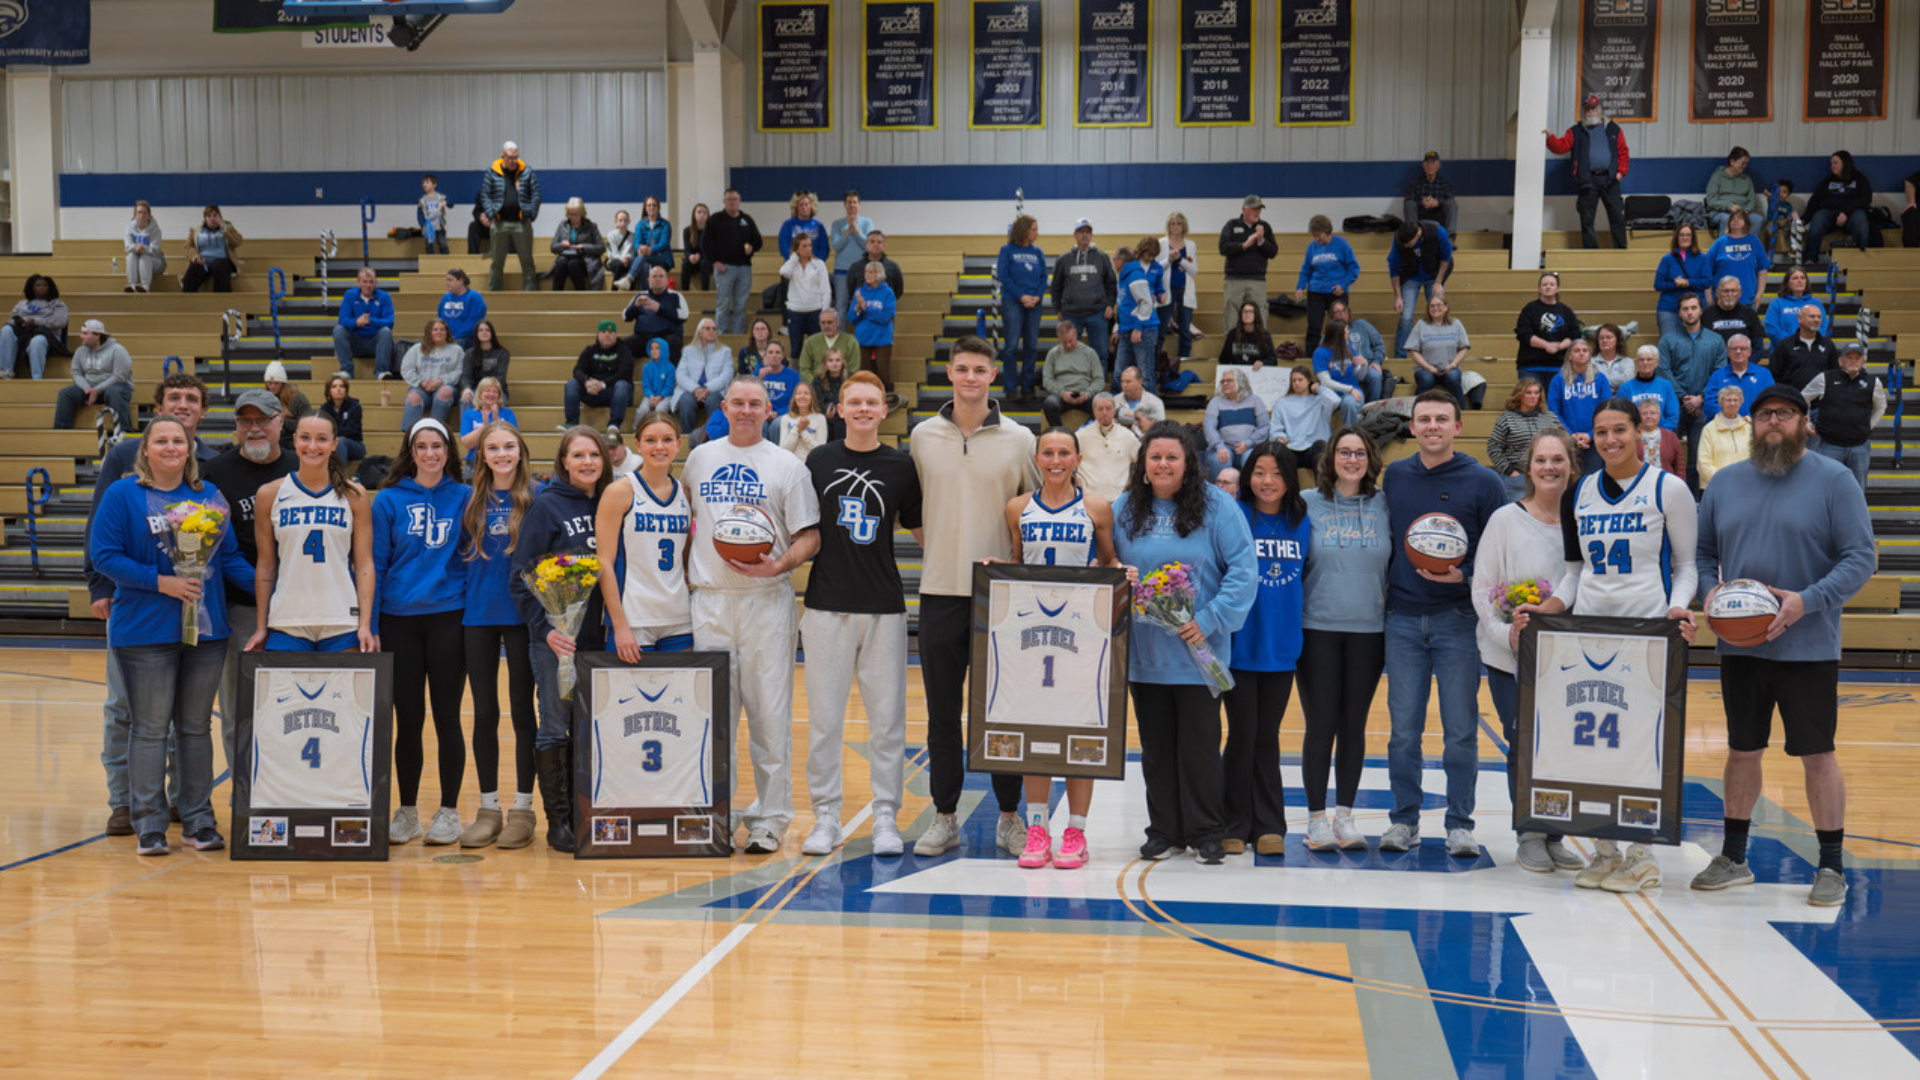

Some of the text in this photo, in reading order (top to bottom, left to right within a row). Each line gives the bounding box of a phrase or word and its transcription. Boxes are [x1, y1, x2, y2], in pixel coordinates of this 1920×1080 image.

[315, 24, 384, 43] STUDENTS
[1714, 44, 1749, 52] COLLEGE
[996, 83, 1020, 93] 2003
[1100, 81, 1125, 91] 2014
[1203, 80, 1228, 90] 2018
[1302, 80, 1329, 90] 2022
[1605, 76, 1631, 86] 2017
[1718, 76, 1745, 86] 2020
[1832, 74, 1860, 84] 2020
[784, 86, 808, 98] 1994
[888, 85, 912, 95] 2001
[1602, 100, 1632, 108] BETHEL
[1716, 100, 1746, 108] BETHEL
[700, 481, 768, 500] BETHEL
[278, 505, 349, 528] BETHEL
[406, 502, 453, 549] BU
[836, 496, 880, 544] BU
[1580, 512, 1647, 536] BETHEL
[1020, 522, 1086, 543] BETHEL
[302, 529, 326, 562] 4
[658, 538, 676, 572] 3
[1043, 547, 1056, 565] 1
[1255, 538, 1302, 560] ETHEL
[1588, 539, 1633, 574] 24
[1021, 625, 1078, 654] BETHEL
[1042, 655, 1054, 688] 1
[1566, 680, 1628, 710] BETHEL
[283, 708, 340, 735] BETHEL
[623, 710, 682, 737] BETHEL
[1573, 711, 1620, 748] 24
[301, 737, 321, 768] 4
[642, 740, 662, 772] 3
